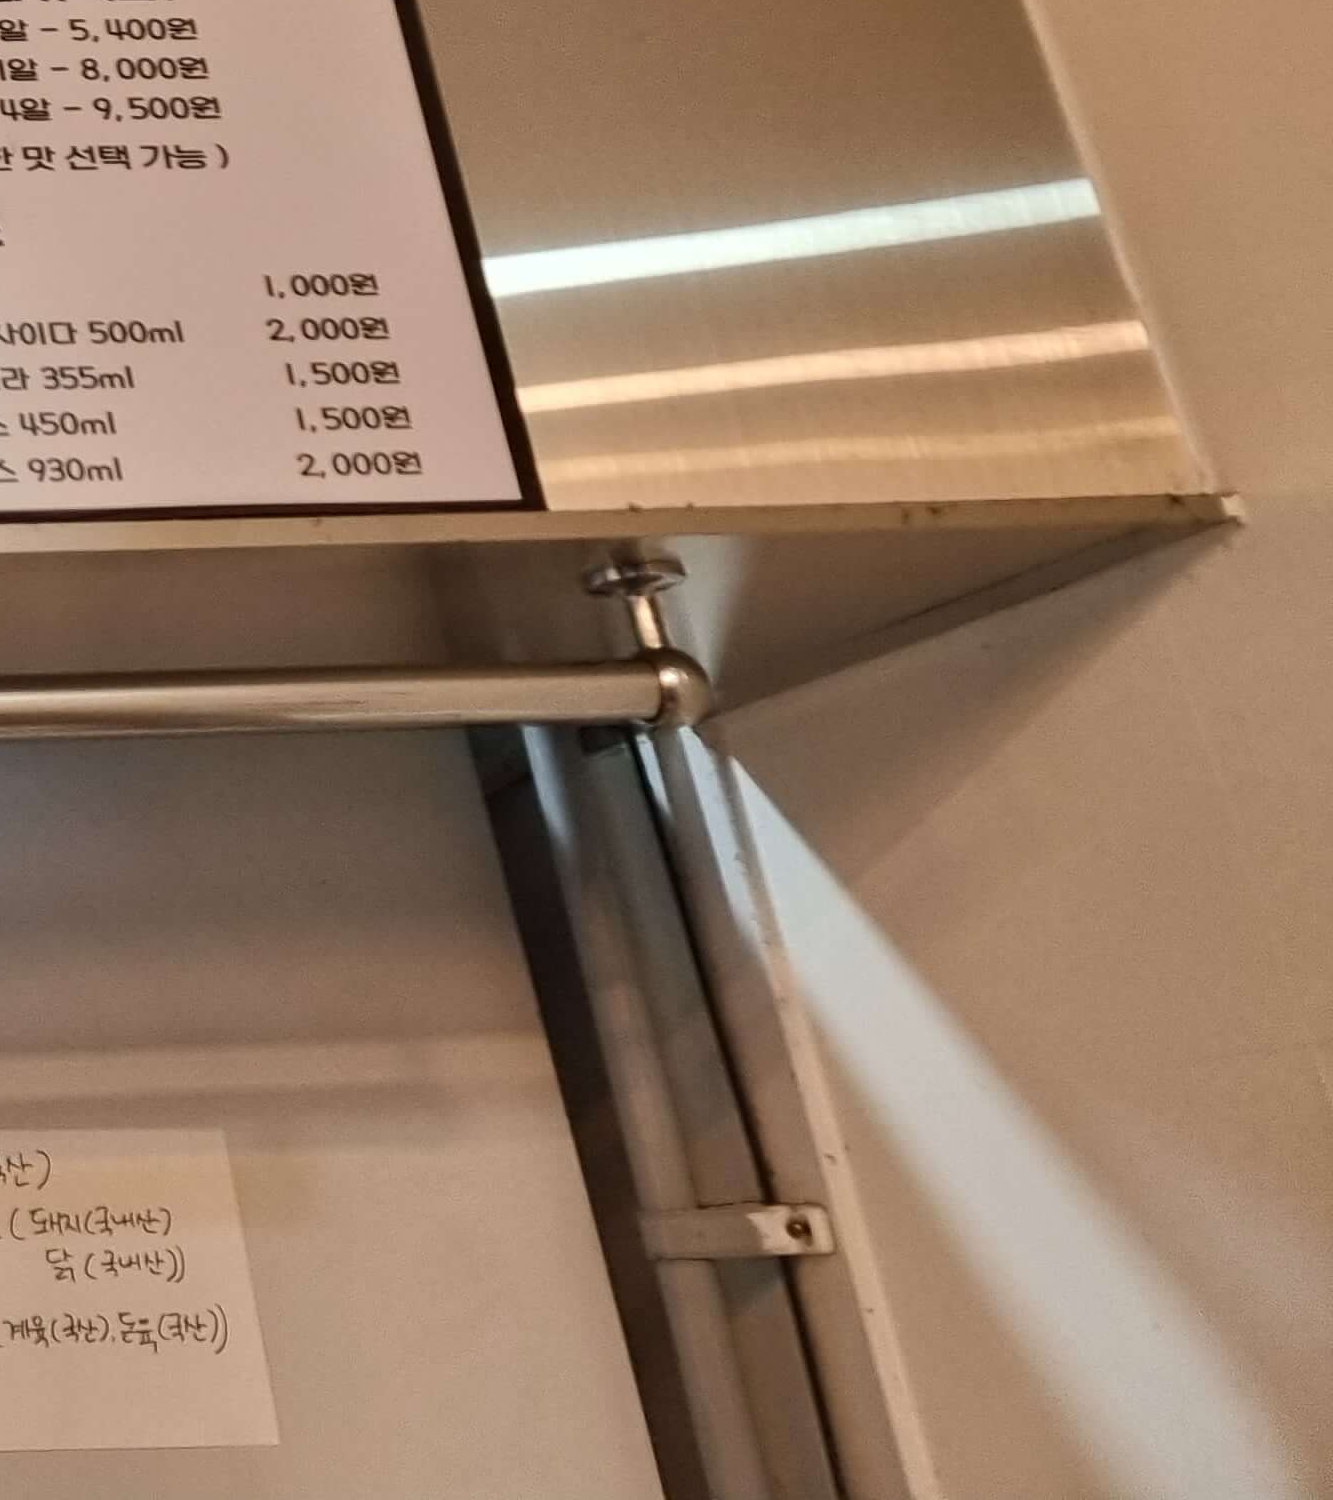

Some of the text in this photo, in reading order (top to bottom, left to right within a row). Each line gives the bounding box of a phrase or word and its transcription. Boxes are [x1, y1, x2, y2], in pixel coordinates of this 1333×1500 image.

[21, 145, 56, 172] 맛
[64, 144, 132, 171] 선택
[87, 320, 185, 345] 500ml
[39, 365, 135, 391] 355ml
[18, 411, 117, 437] 450ml
[26, 456, 123, 483] 930ml
